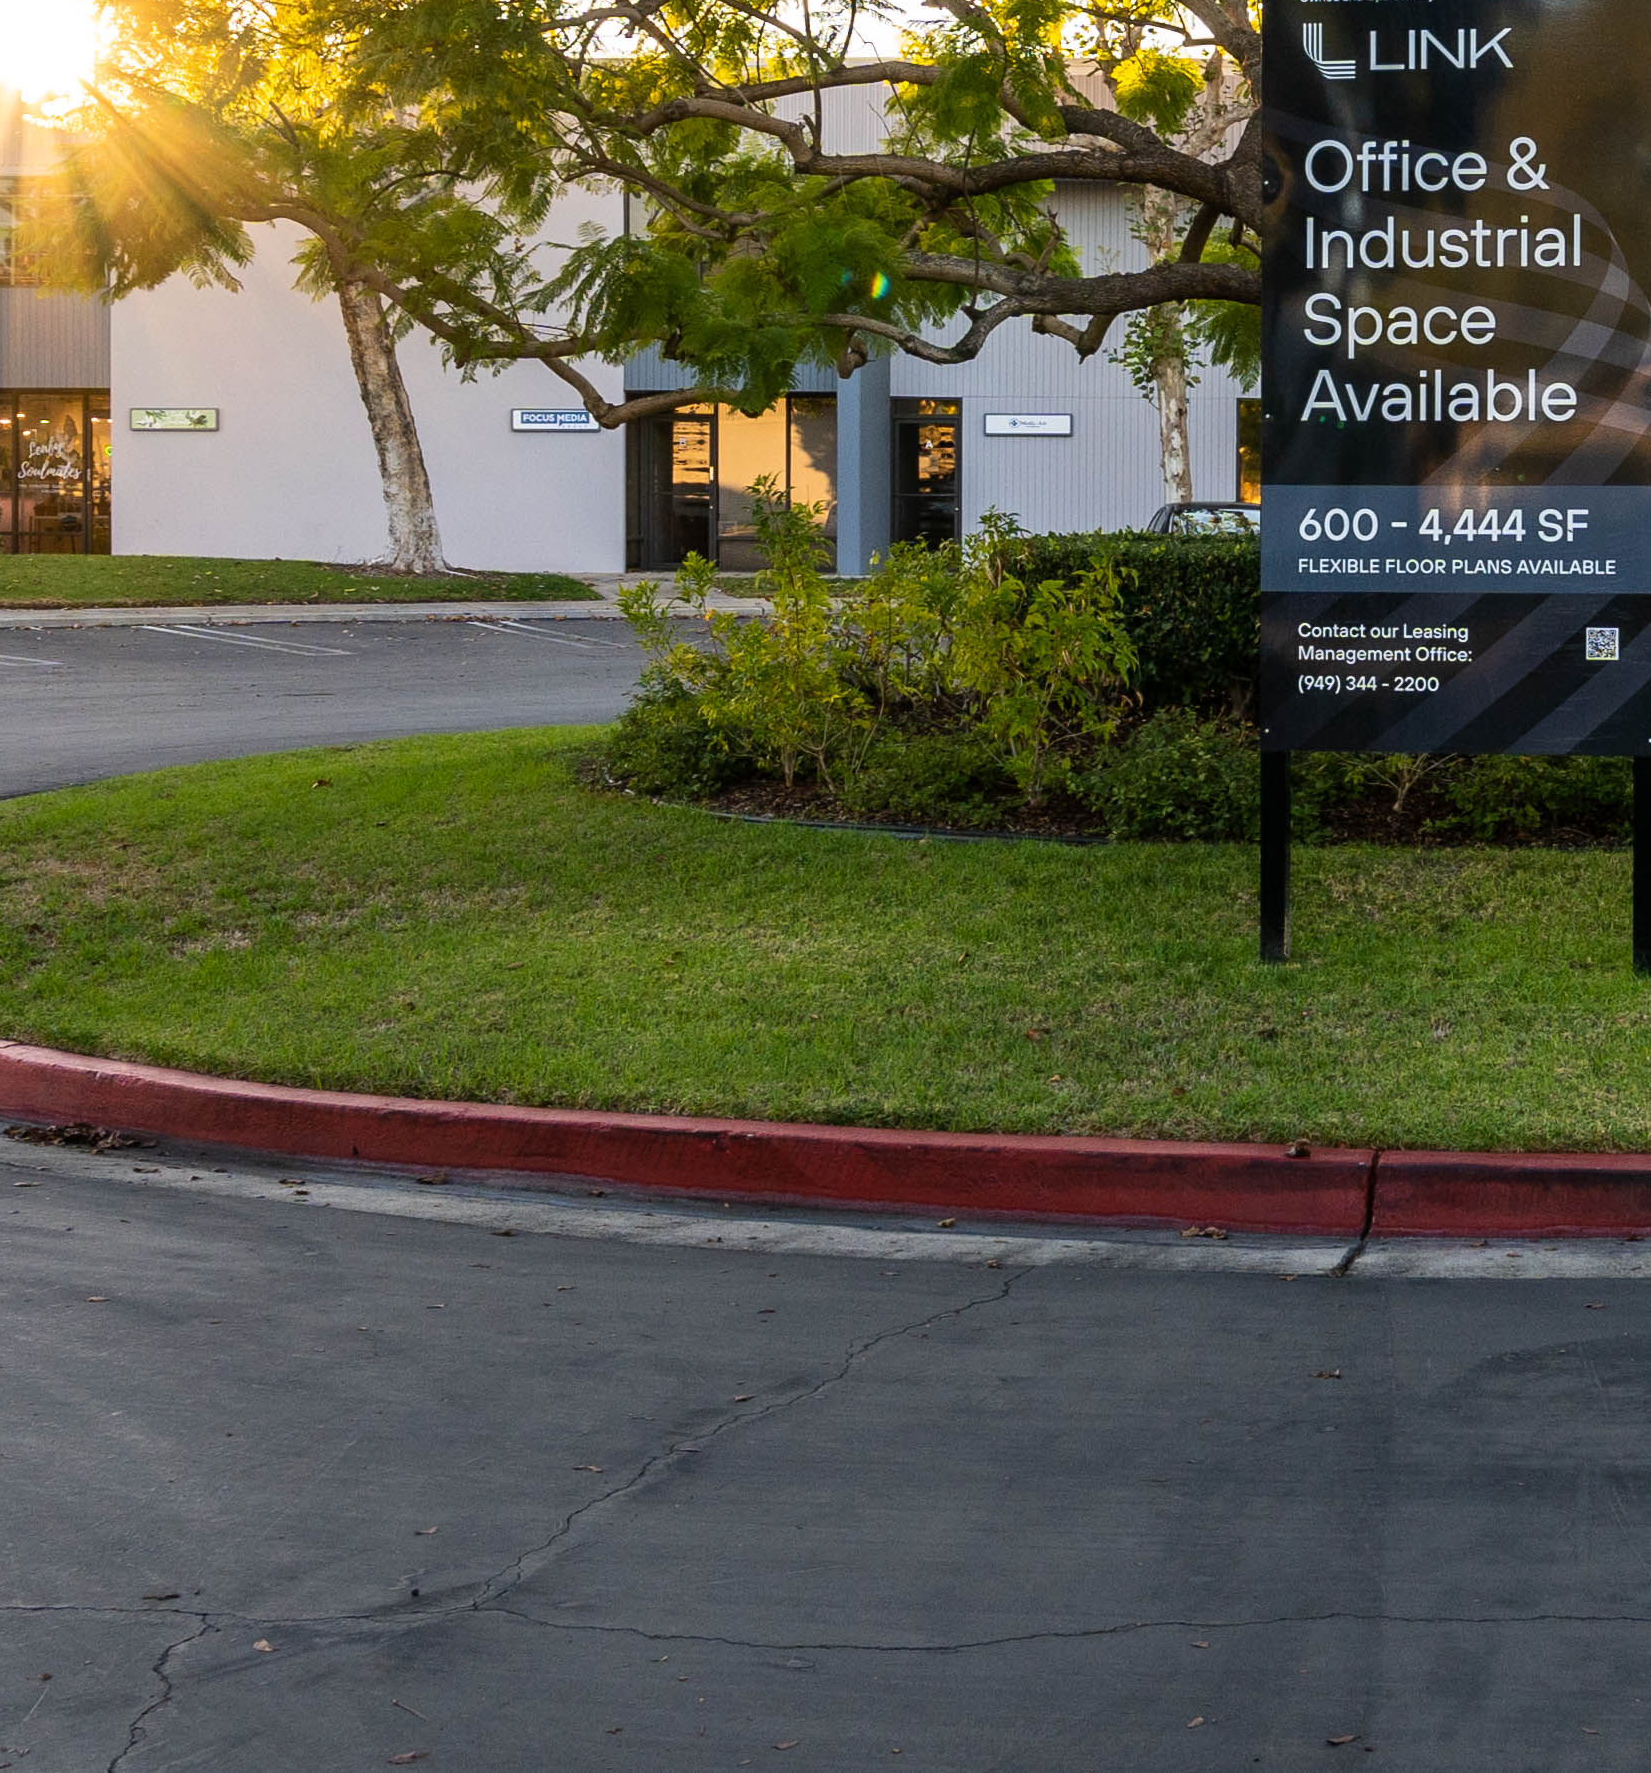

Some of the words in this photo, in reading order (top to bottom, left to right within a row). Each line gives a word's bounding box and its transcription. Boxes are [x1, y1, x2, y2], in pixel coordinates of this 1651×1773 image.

[1369, 27, 1514, 71] LINK
[1305, 139, 1488, 193] Office
[1506, 136, 1550, 191] &
[1306, 213, 1581, 268] Industrial
[1303, 292, 1496, 359] Space
[1300, 369, 1578, 422] Available
[523, 413, 555, 422] FOCUS
[556, 413, 588, 424] MEDIA
[1299, 508, 1378, 541] 600
[1418, 508, 1526, 545] 4,444
[1538, 508, 1589, 542] SF
[1298, 558, 1380, 573] FLEXIBLE
[1385, 559, 1446, 574] FLOOR
[1452, 559, 1512, 574] PLANS
[1516, 560, 1616, 575] AVAILABLE
[1298, 623, 1366, 638] Contact
[1371, 627, 1399, 638] our
[1403, 623, 1469, 642] Leasing
[1298, 645, 1411, 665] Management
[1415, 646, 1473, 662] Office:
[1298, 675, 1341, 694] (949)
[1346, 677, 1377, 691] 344
[1394, 677, 1439, 692] 2200
